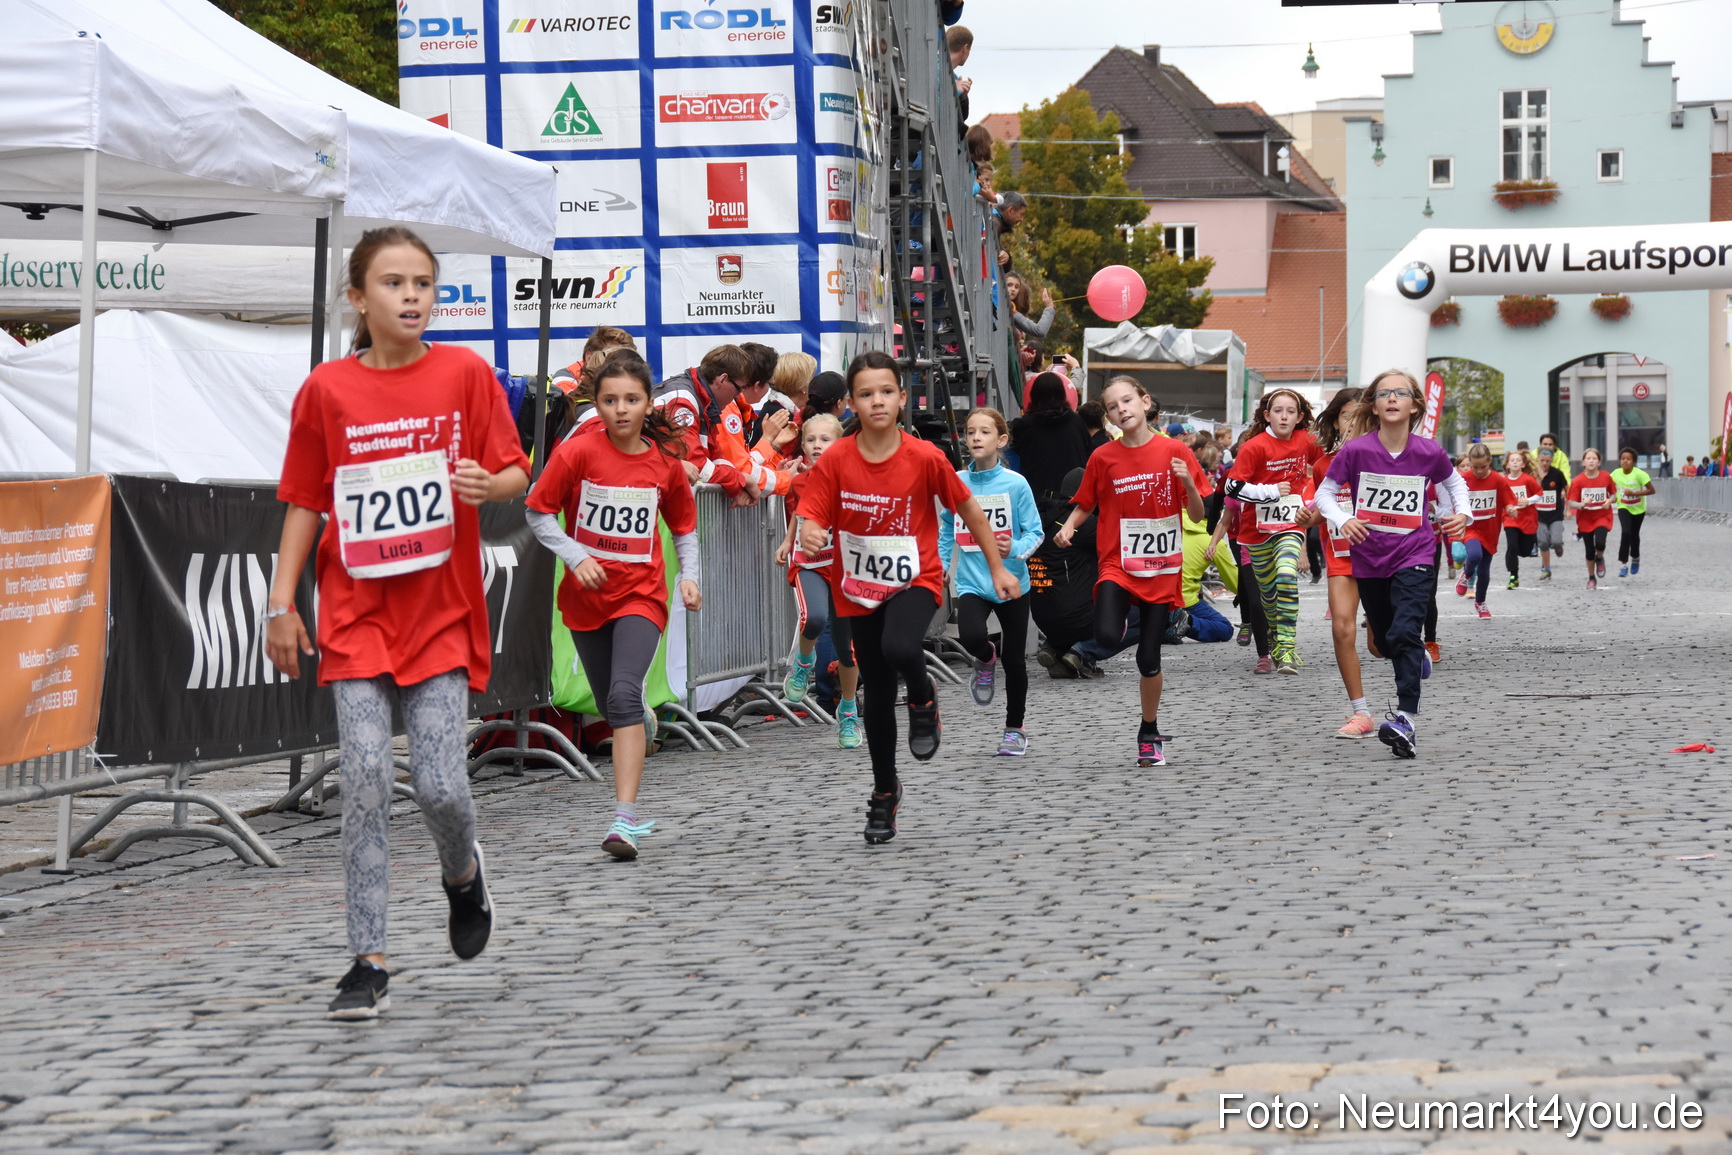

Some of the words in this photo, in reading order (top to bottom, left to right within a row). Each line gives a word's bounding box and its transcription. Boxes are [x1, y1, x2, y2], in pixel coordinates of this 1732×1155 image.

[398, 10, 478, 39] ÖDL
[540, 16, 631, 32] VARIOTEC
[420, 35, 478, 50] energie
[727, 27, 786, 42] energie
[664, 95, 755, 115] charivari
[708, 199, 745, 217] Braun
[1449, 243, 1552, 273] BMW
[699, 289, 764, 301] Neumarkter
[513, 300, 567, 312] stadterke
[570, 300, 618, 310] neumarkt
[687, 301, 775, 317] Lammsbräu
[346, 417, 430, 439] Neumarkter
[348, 433, 415, 455] Stadtlauf
[1112, 473, 1154, 486] Neumarkter
[1115, 482, 1147, 494] Stadtlauf
[613, 490, 652, 501] BOCK
[1366, 487, 1419, 513] 7223
[346, 481, 445, 534] 7202
[841, 501, 879, 514] tadtlauf
[585, 501, 649, 534] 7038
[1380, 515, 1397, 525] Ella
[64, 522, 95, 538] Partner
[379, 539, 423, 560] Lucia
[596, 537, 628, 552] Alicia
[1128, 529, 1177, 555] 7207
[849, 550, 912, 583] 7426
[19, 649, 46, 669] Melden
[62, 689, 78, 707] 897
